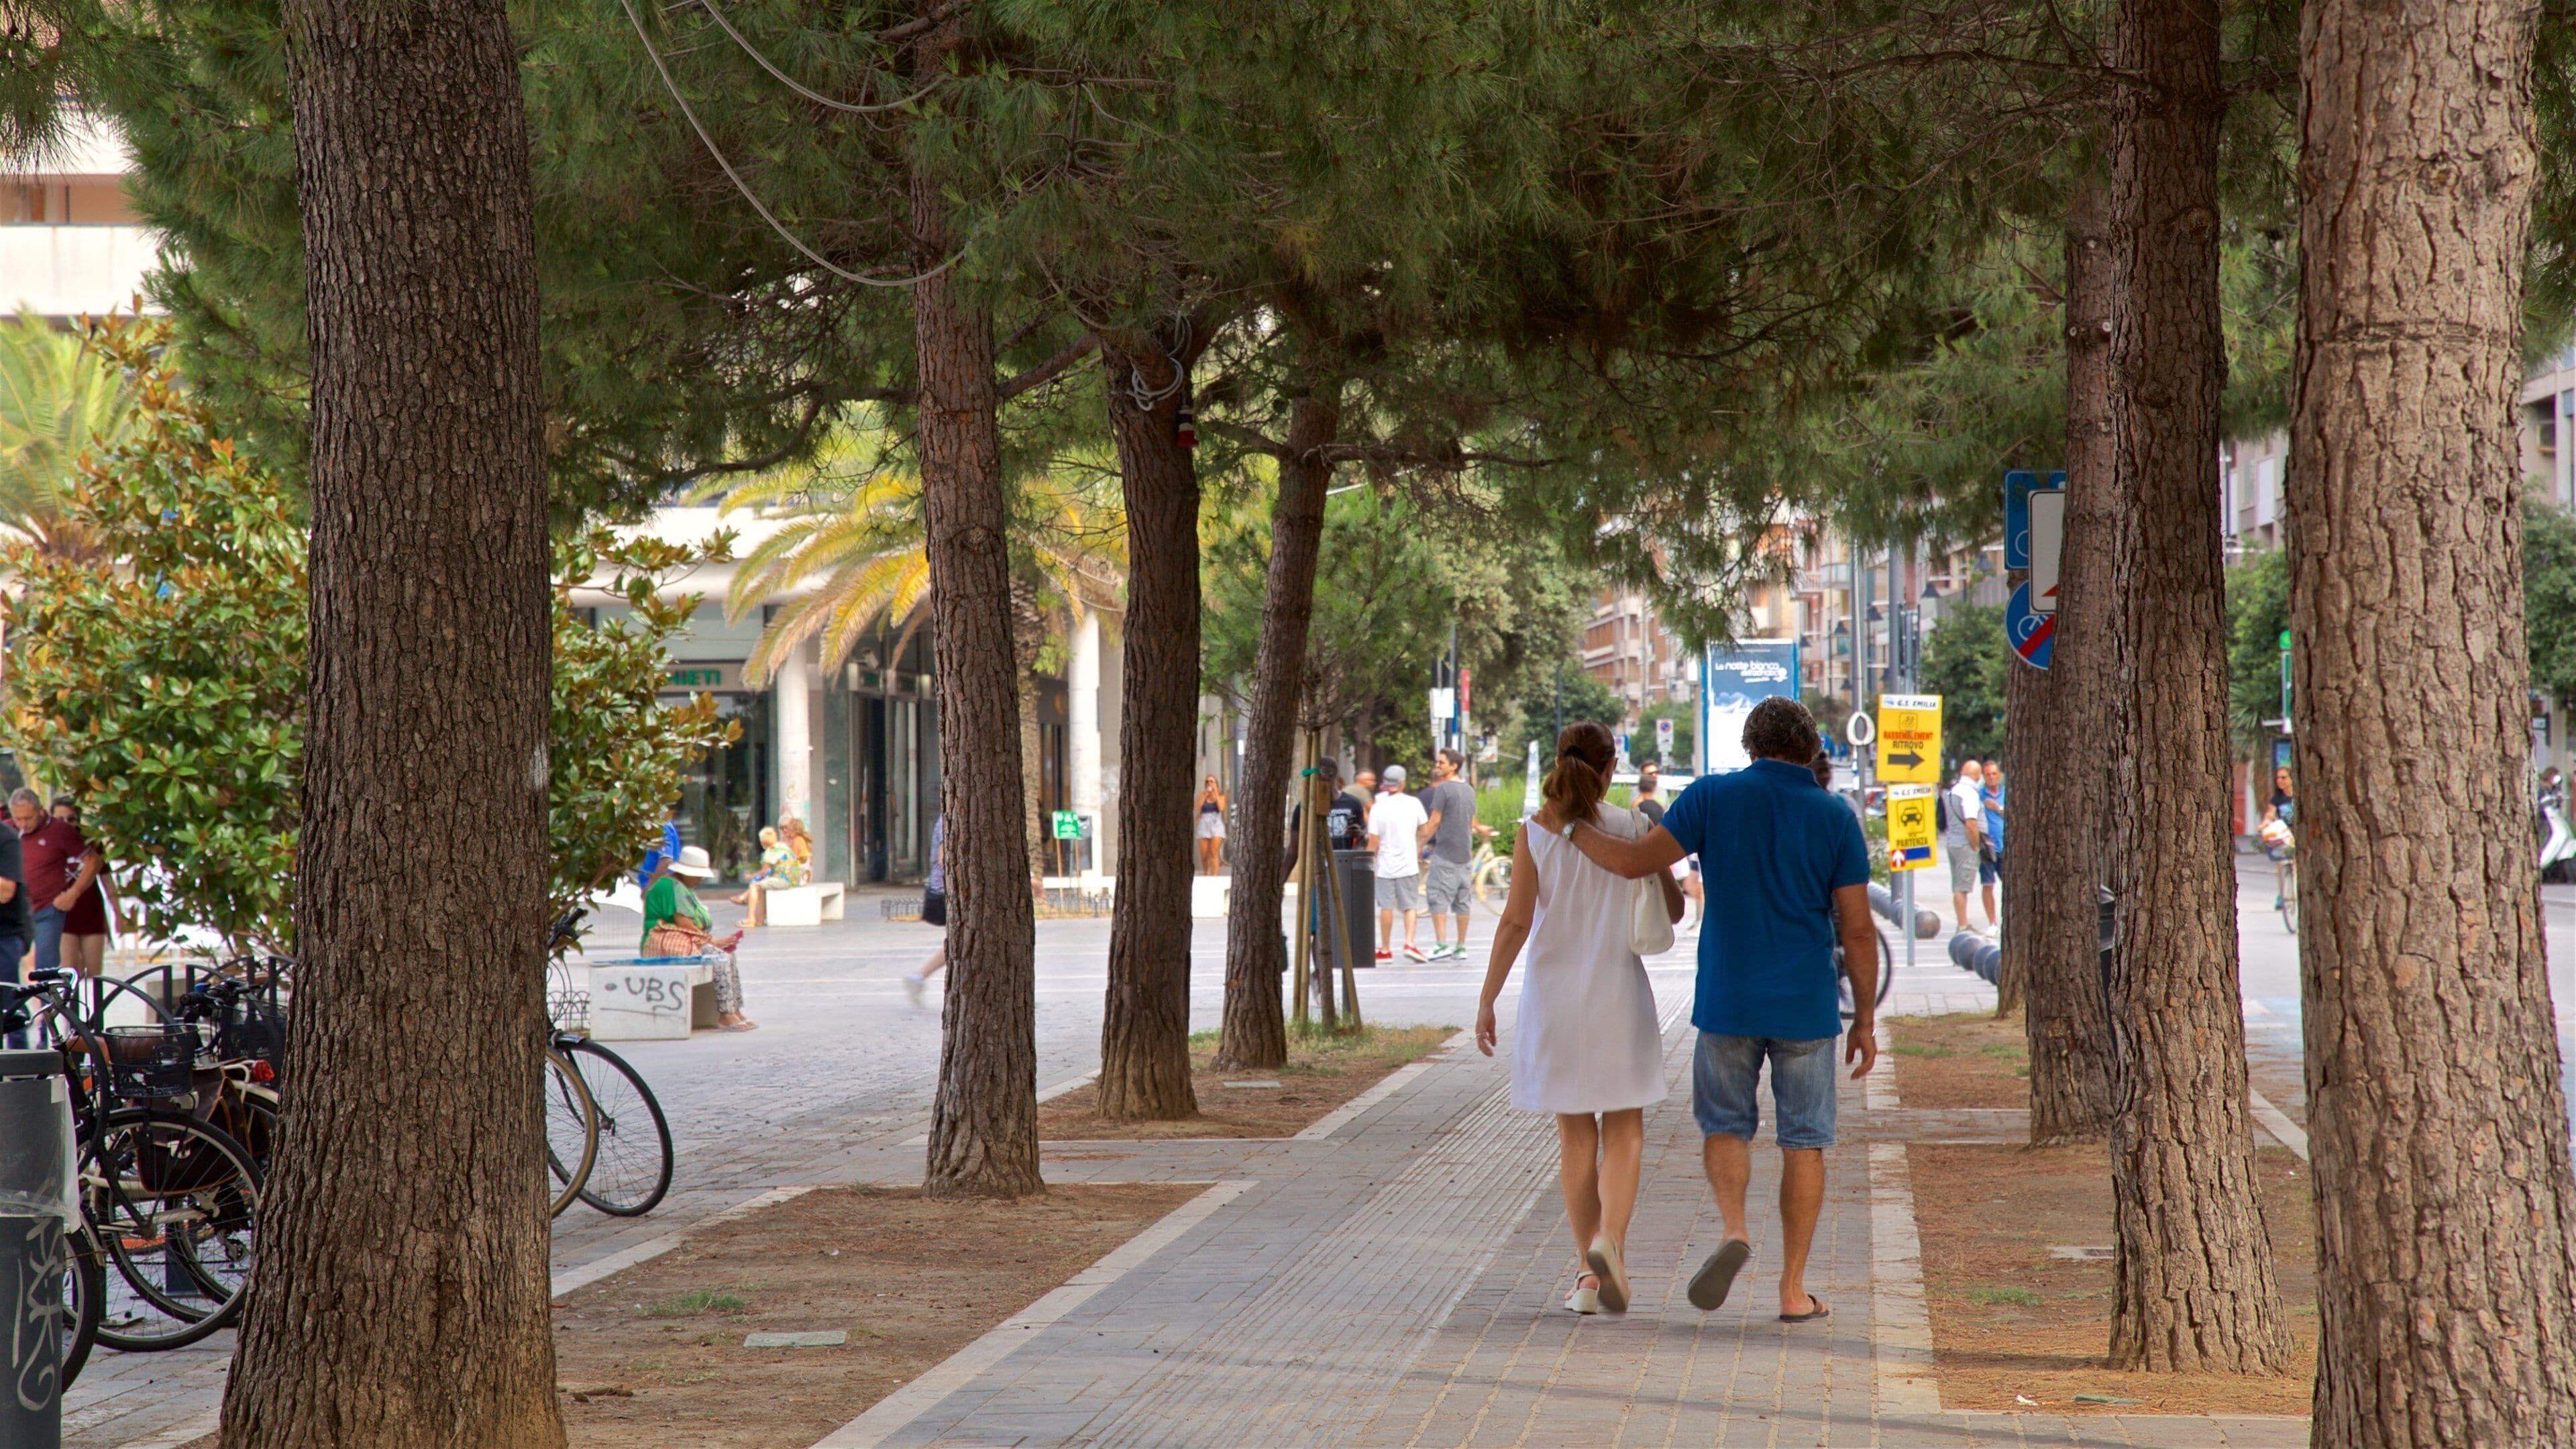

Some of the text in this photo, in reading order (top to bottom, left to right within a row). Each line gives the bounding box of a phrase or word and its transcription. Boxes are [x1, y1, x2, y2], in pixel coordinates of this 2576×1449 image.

[1892, 741, 1924, 750] RITROVO
[1896, 837, 1929, 848] PARTENZA
[625, 976, 686, 1011] UBS
